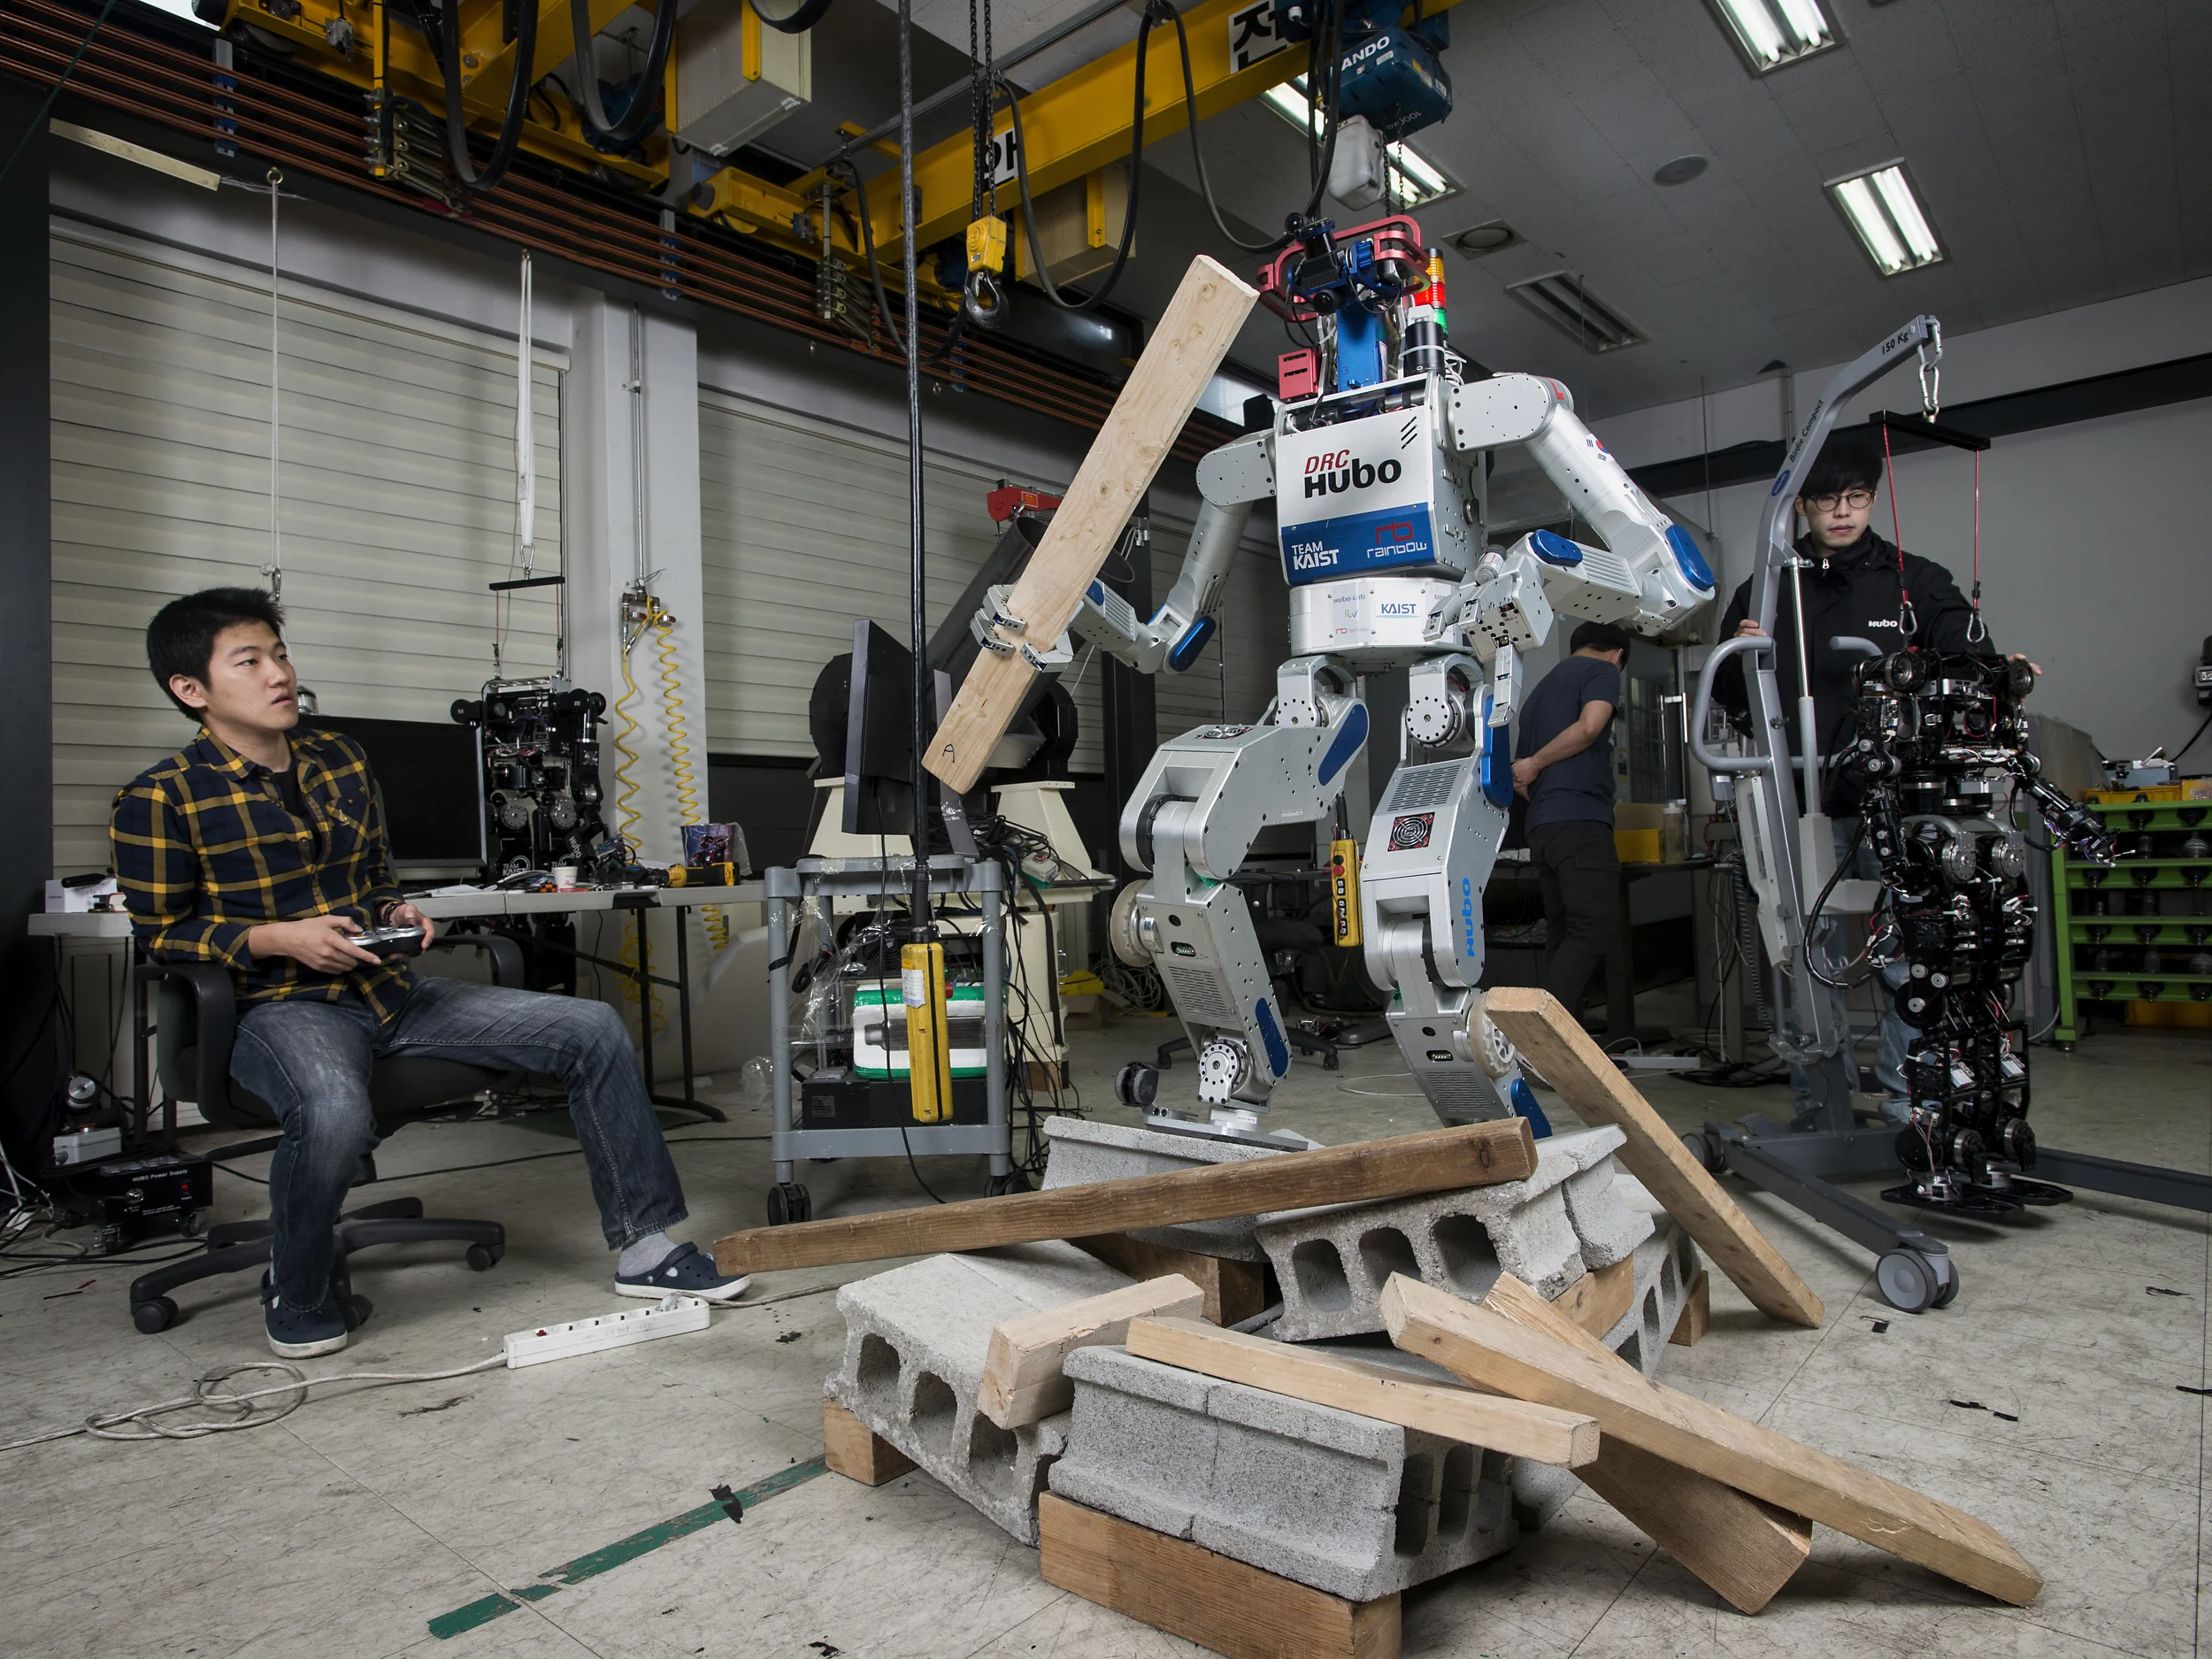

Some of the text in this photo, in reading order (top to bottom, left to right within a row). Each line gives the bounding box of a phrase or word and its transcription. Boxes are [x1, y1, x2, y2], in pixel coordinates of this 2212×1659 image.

[1331, 35, 1390, 77] ANDO
[1882, 332, 1909, 354] 150 Kg
[1789, 399, 1824, 463] Birdie Compact
[1304, 449, 1350, 474] DRC
[1292, 541, 1324, 556] TEAM
[1293, 549, 1340, 571] KAIST
[1381, 603, 1417, 614] KAIST
[941, 743, 956, 764] A
